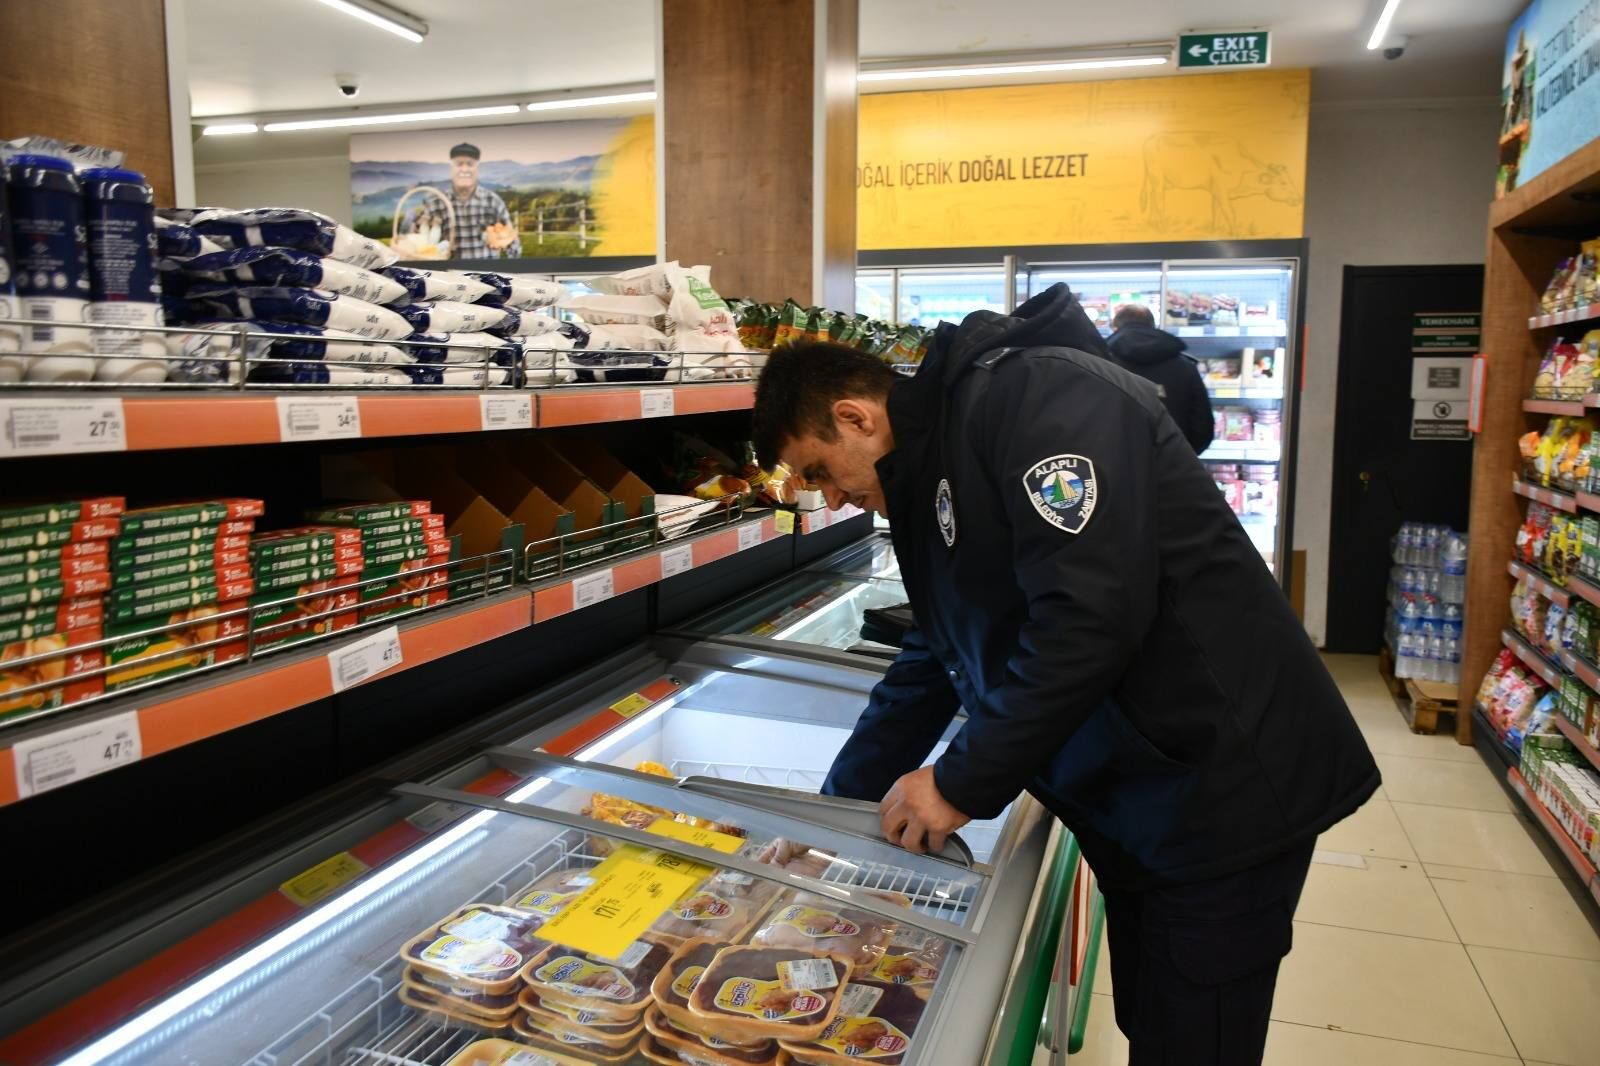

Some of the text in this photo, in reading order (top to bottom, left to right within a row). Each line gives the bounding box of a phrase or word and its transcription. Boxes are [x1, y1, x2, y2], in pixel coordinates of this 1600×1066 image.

[1213, 36, 1258, 51] EXIT
[1208, 49, 1260, 65] ÇIKIŞ
[900, 158, 953, 191] İÇERİK
[959, 155, 1017, 184] DOĞAL
[1022, 153, 1089, 180] LEZZET
[89, 421, 107, 437] 27
[1034, 458, 1078, 479] ALAPLI
[1031, 491, 1065, 526] BELEDİYE
[339, 595, 347, 607] 3
[224, 621, 232, 635] 3
[74, 658, 84, 671] 3
[104, 742, 121, 760] 47
